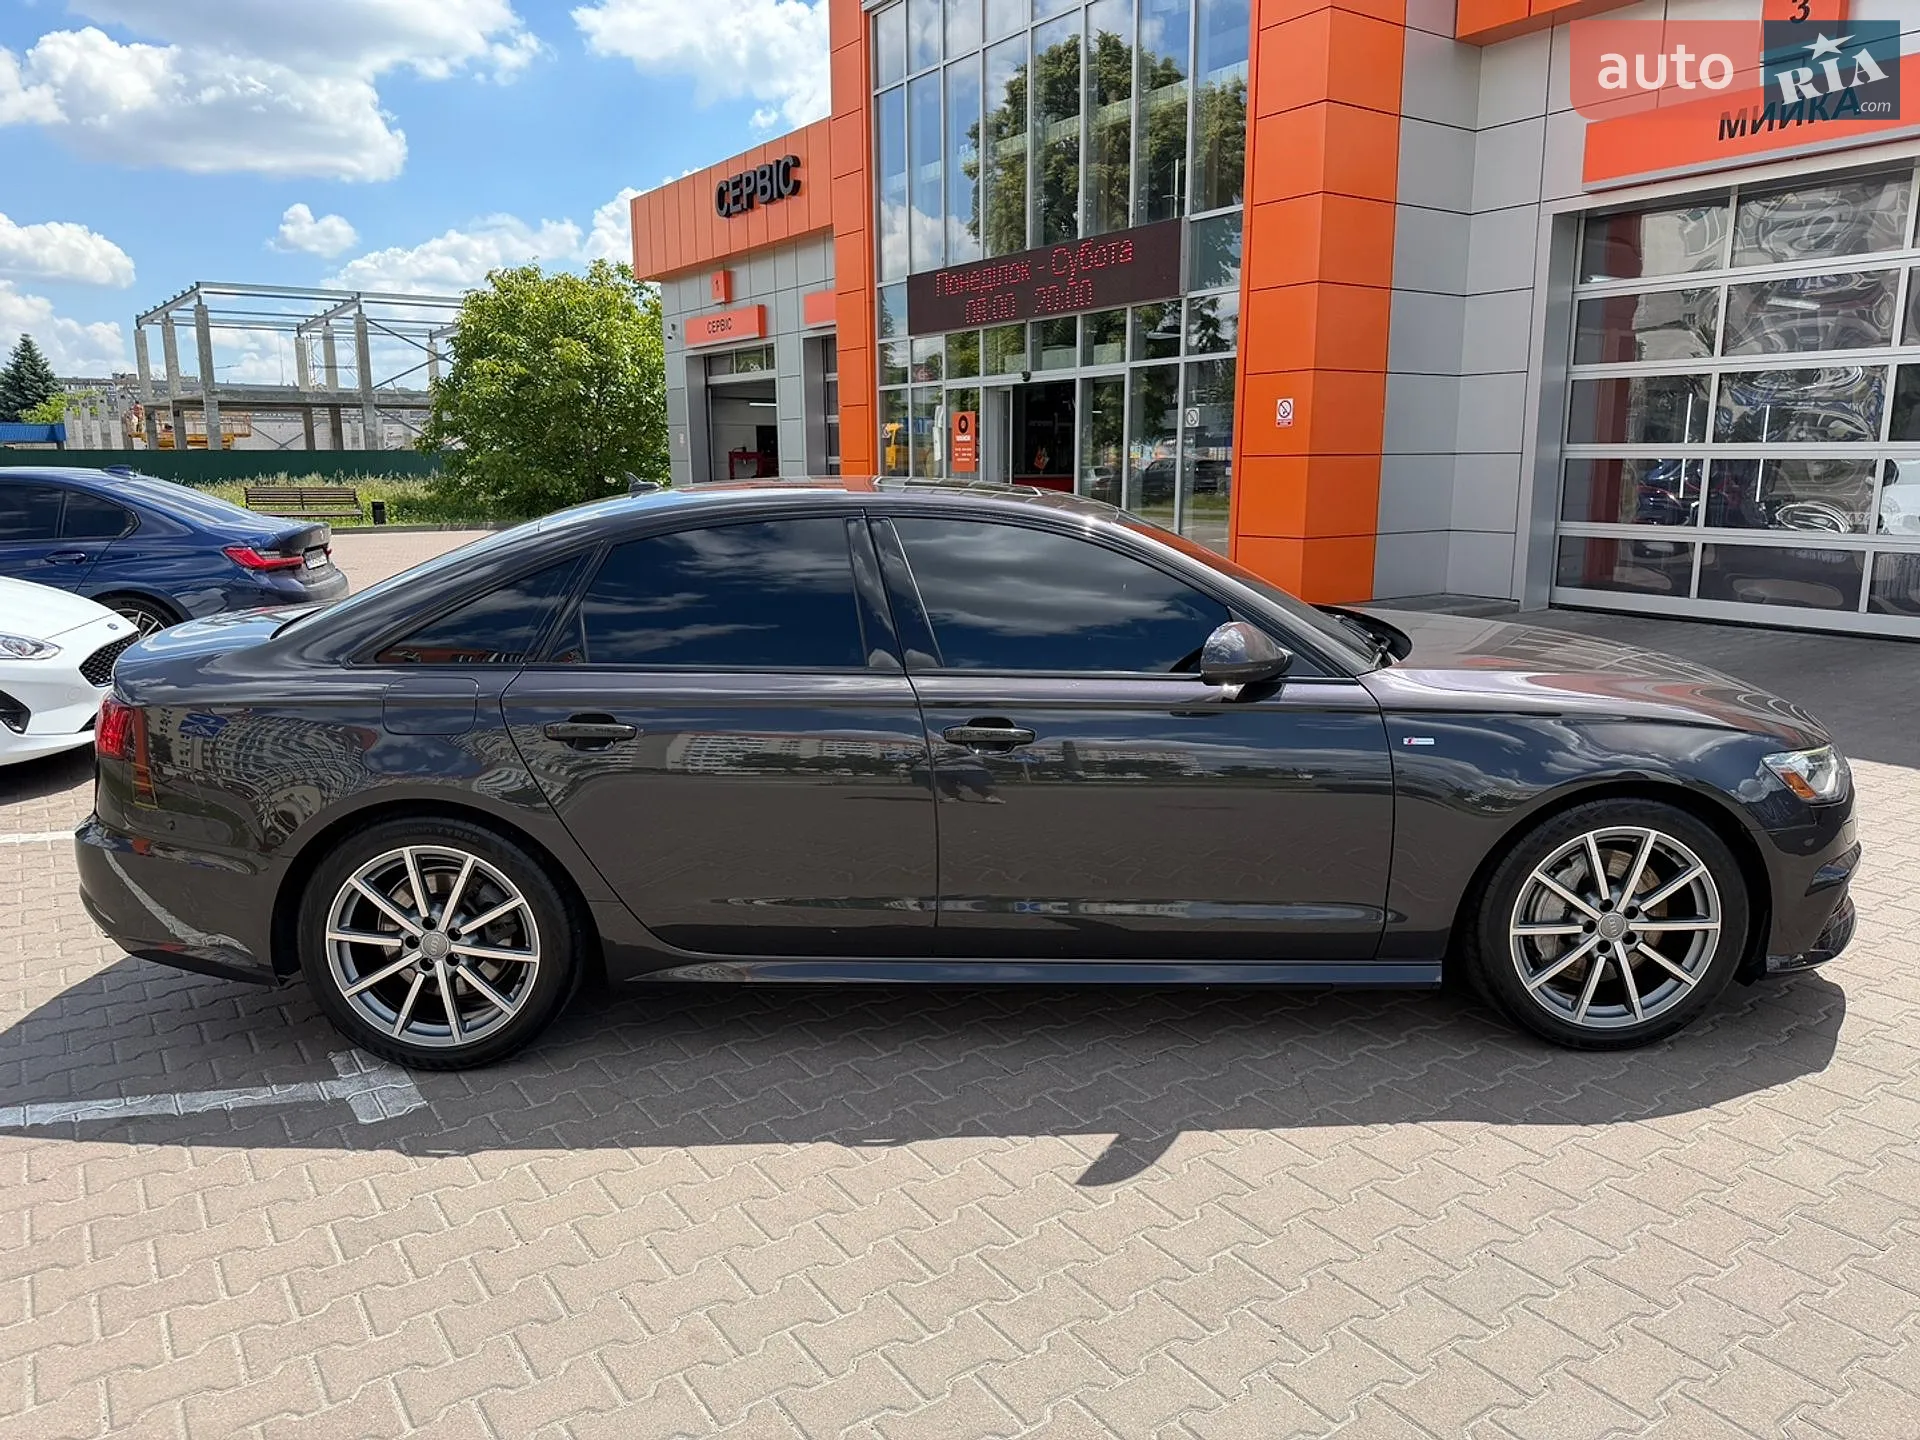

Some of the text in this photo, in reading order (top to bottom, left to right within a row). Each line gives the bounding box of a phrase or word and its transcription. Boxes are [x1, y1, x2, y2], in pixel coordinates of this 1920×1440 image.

[1789, 0, 1811, 24] 3
[715, 154, 802, 218] СЕРВІС
[1051, 238, 1134, 287] Субота
